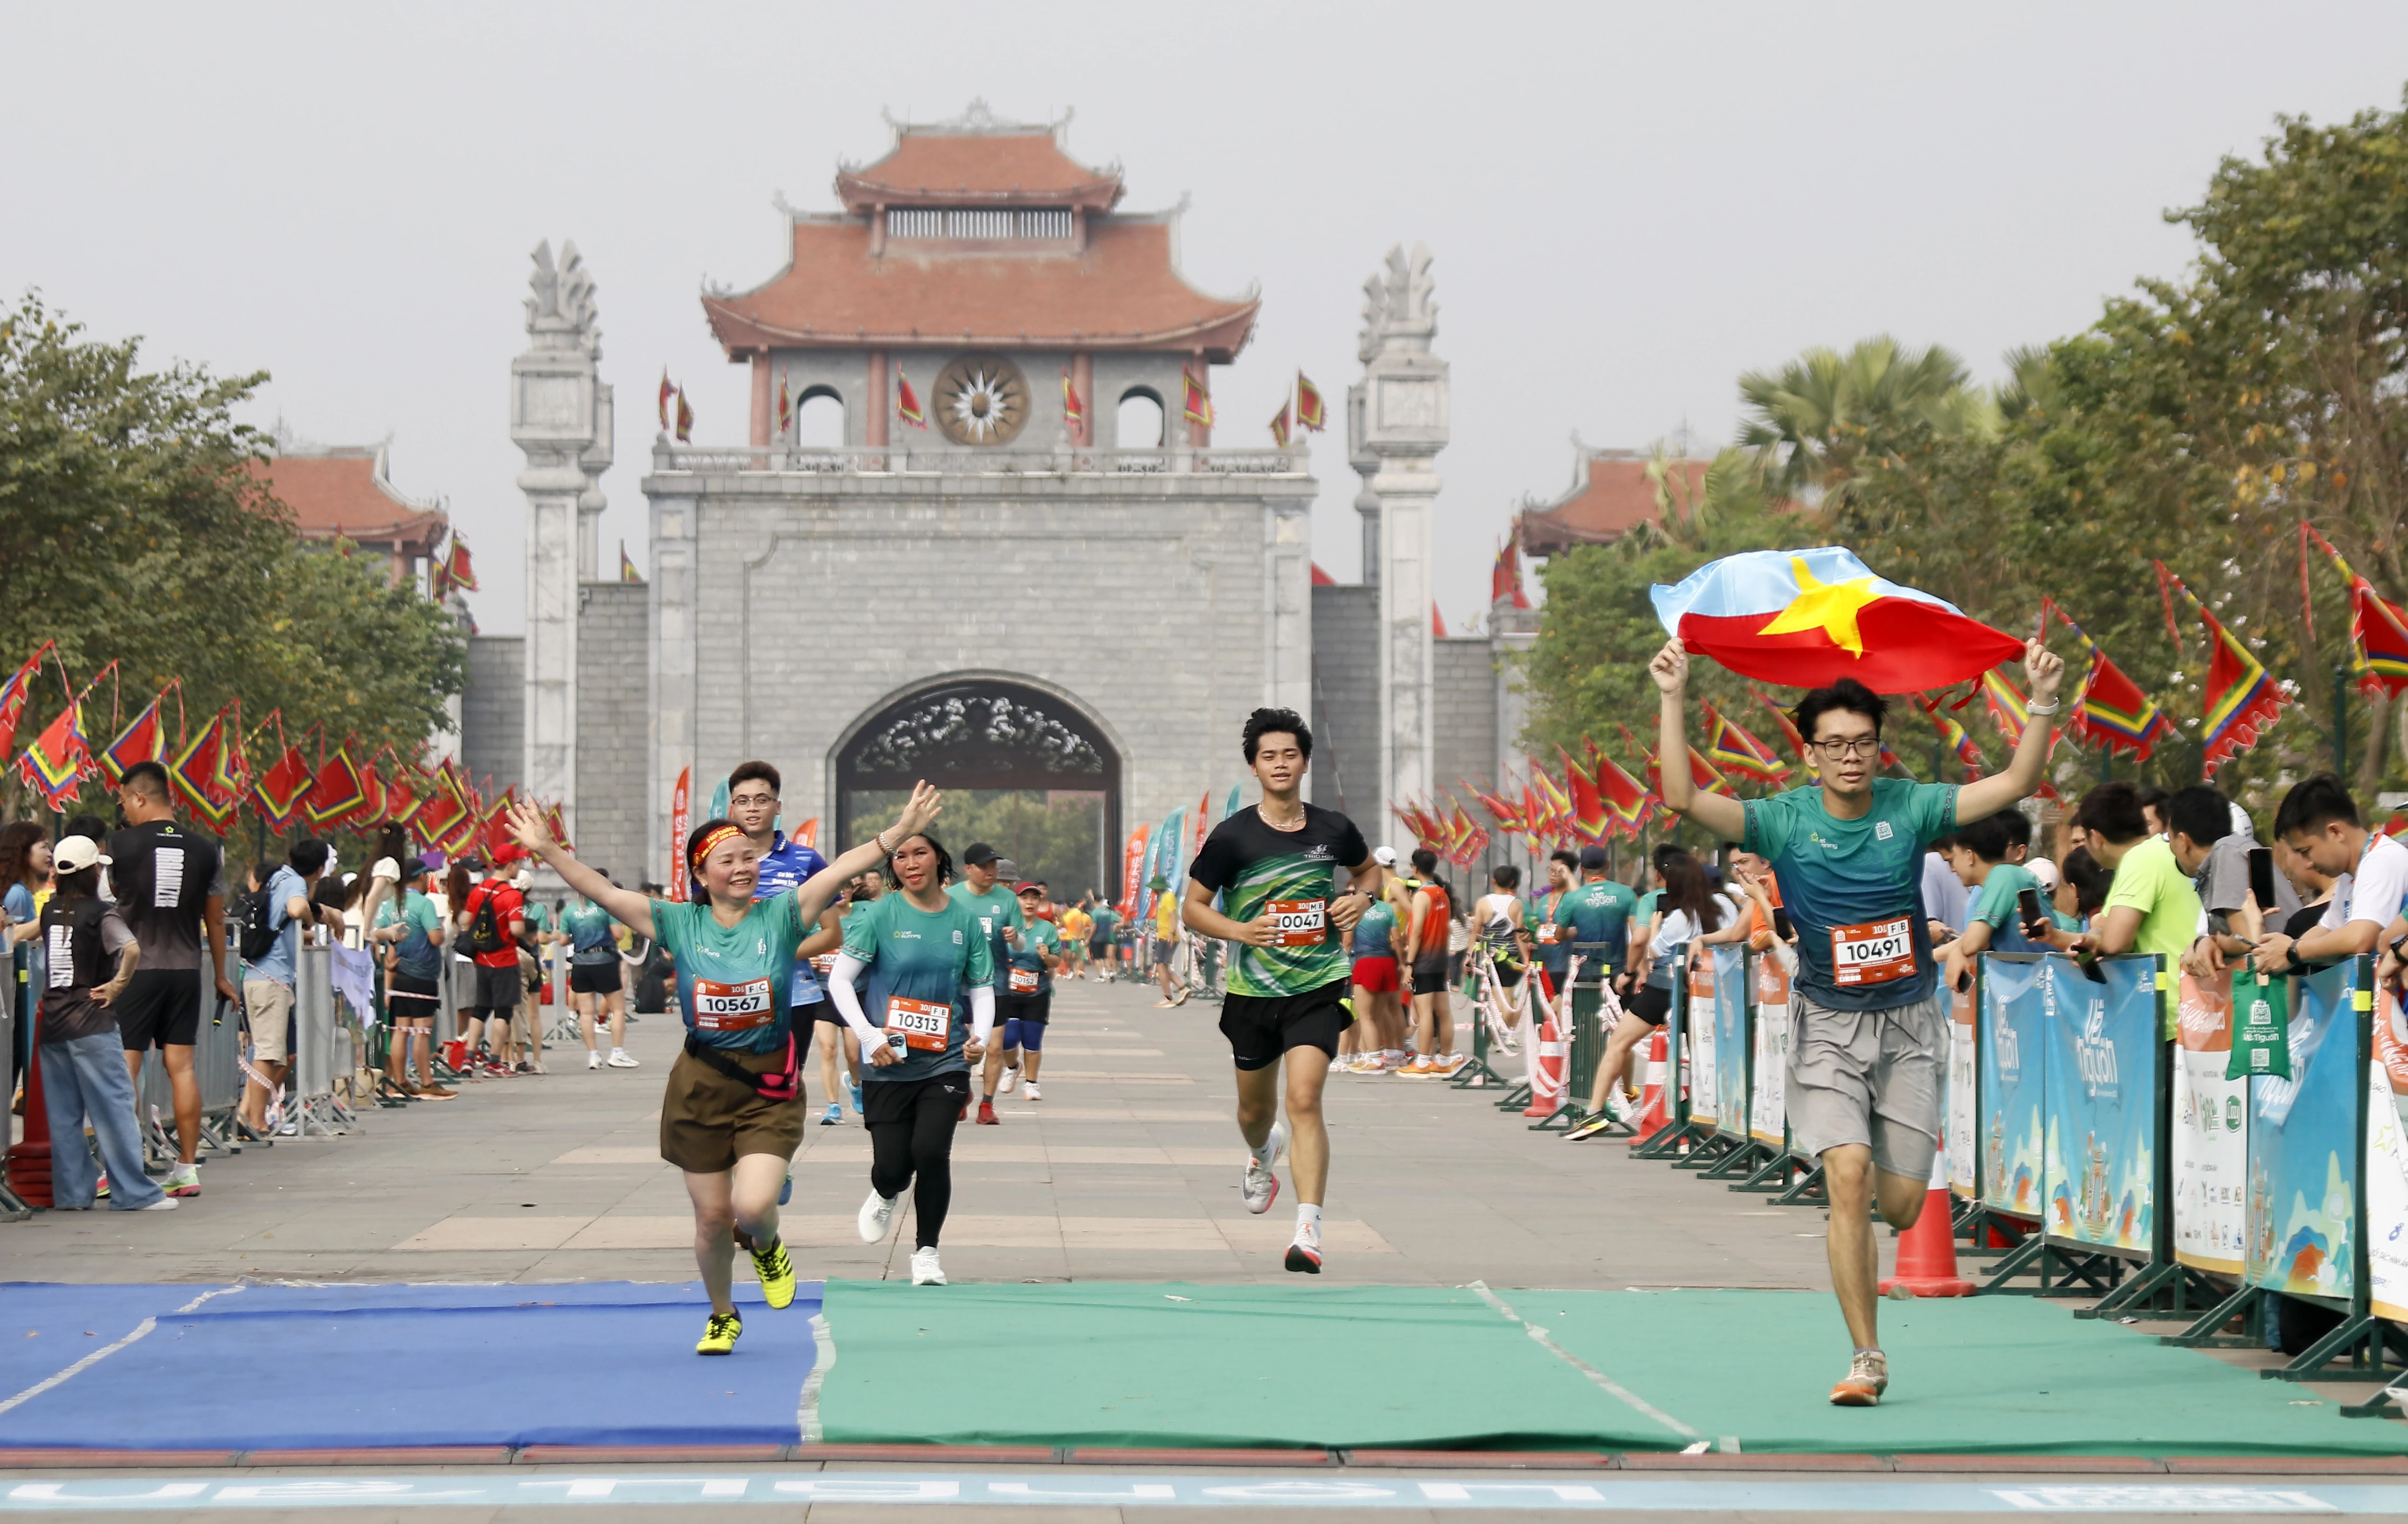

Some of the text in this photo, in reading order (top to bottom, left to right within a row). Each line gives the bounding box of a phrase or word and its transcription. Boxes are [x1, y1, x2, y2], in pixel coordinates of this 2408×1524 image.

[154, 847, 185, 908] ORGANIZER
[1281, 913, 1320, 928] 0047
[1873, 925, 1883, 934] 10
[1847, 937, 1902, 960] 10491
[1014, 975, 1034, 985] 10152
[706, 996, 761, 1012] 10567
[898, 1013, 939, 1031] 10313
